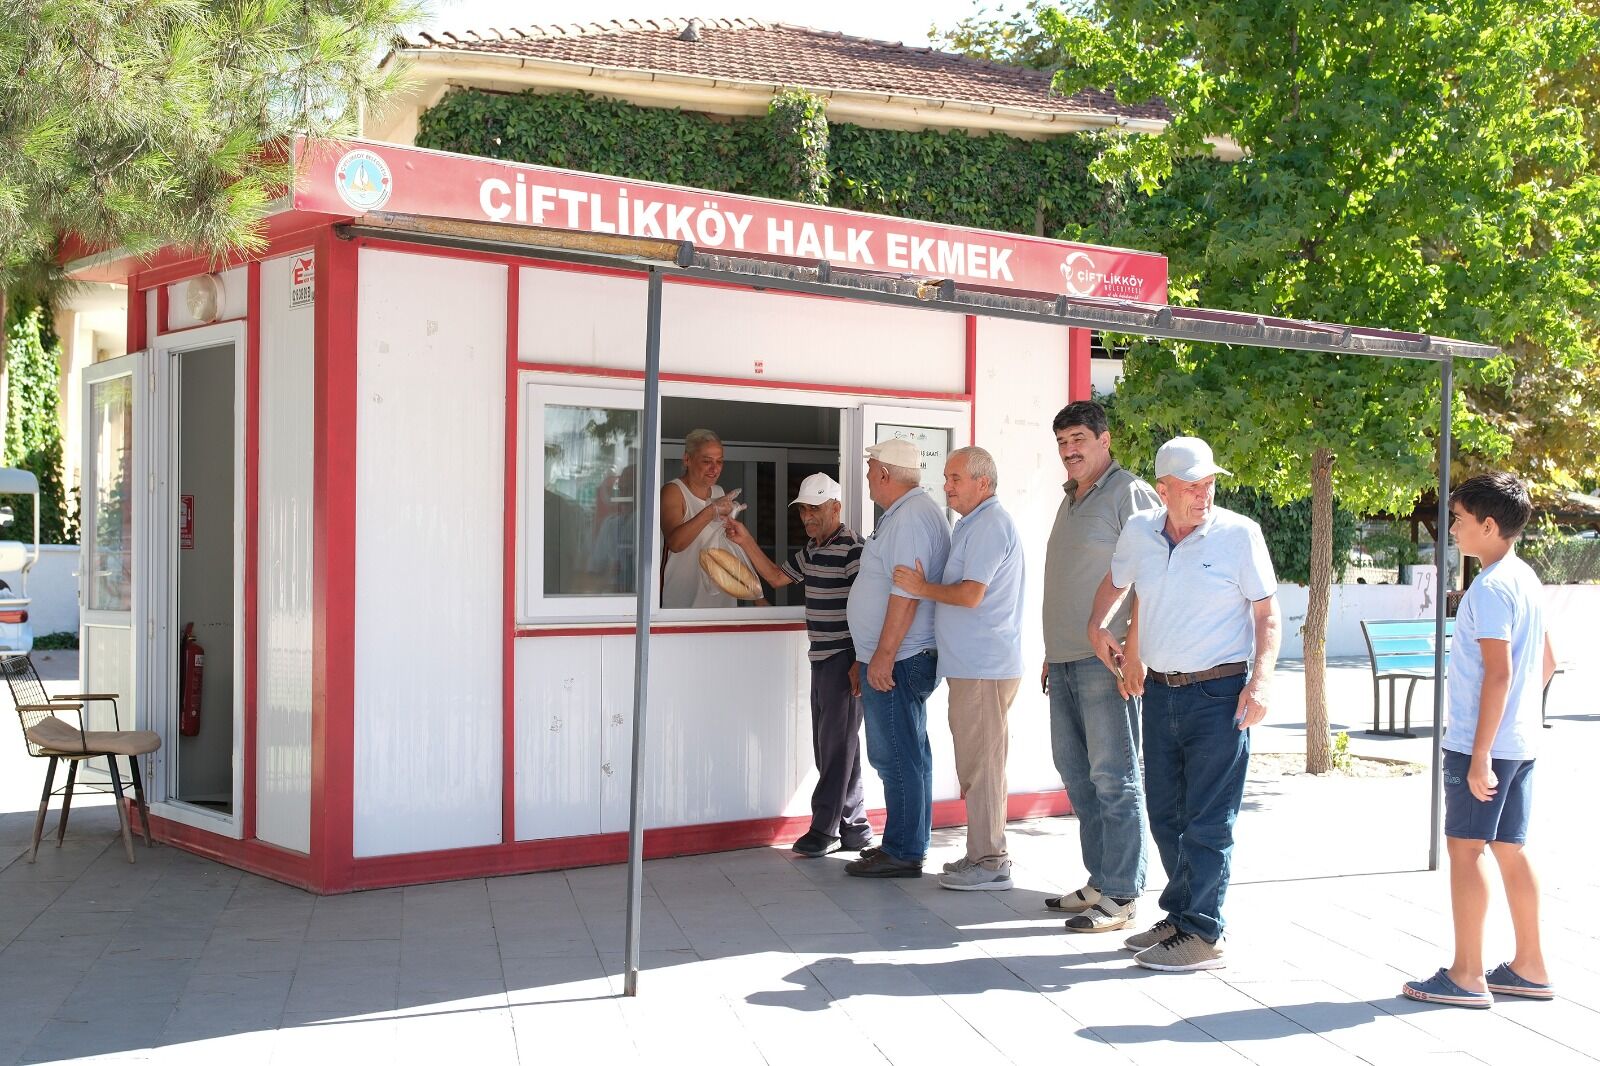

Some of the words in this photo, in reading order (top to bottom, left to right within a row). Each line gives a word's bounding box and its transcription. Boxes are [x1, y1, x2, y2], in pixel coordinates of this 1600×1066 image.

[479, 173, 753, 249] ÇİFTLİKKÖY
[767, 217, 875, 265] HALK
[887, 232, 1014, 282] EKMEK
[1077, 269, 1144, 287] ÇİFTLİKKÖY
